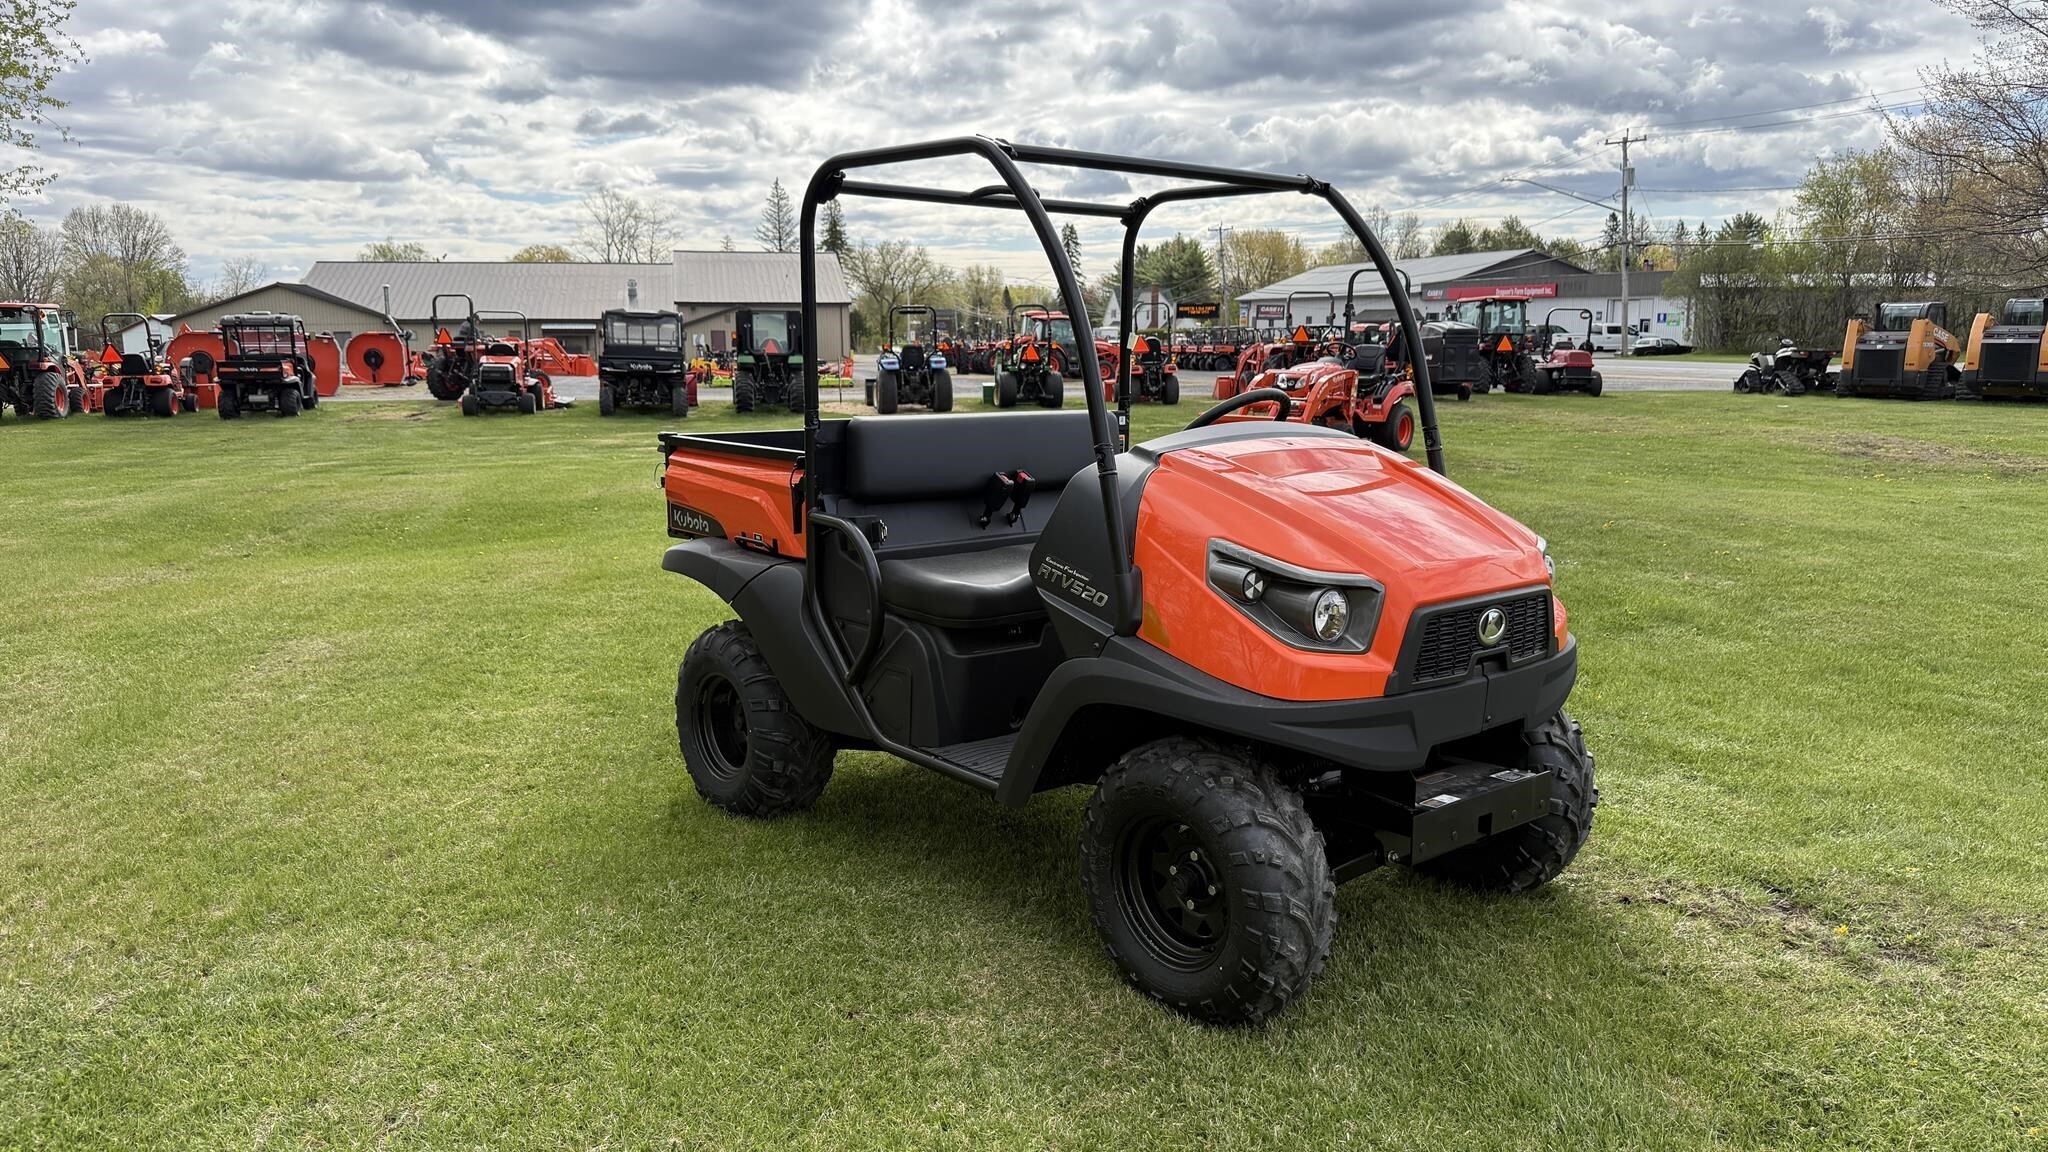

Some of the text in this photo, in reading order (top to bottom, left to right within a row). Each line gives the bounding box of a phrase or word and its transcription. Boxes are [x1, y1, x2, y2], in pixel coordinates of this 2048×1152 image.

[1525, 287, 1545, 297] Equipment
[1933, 327, 1949, 342] CASE
[673, 509, 710, 533] Kubota
[1037, 562, 1109, 607] RTV520
